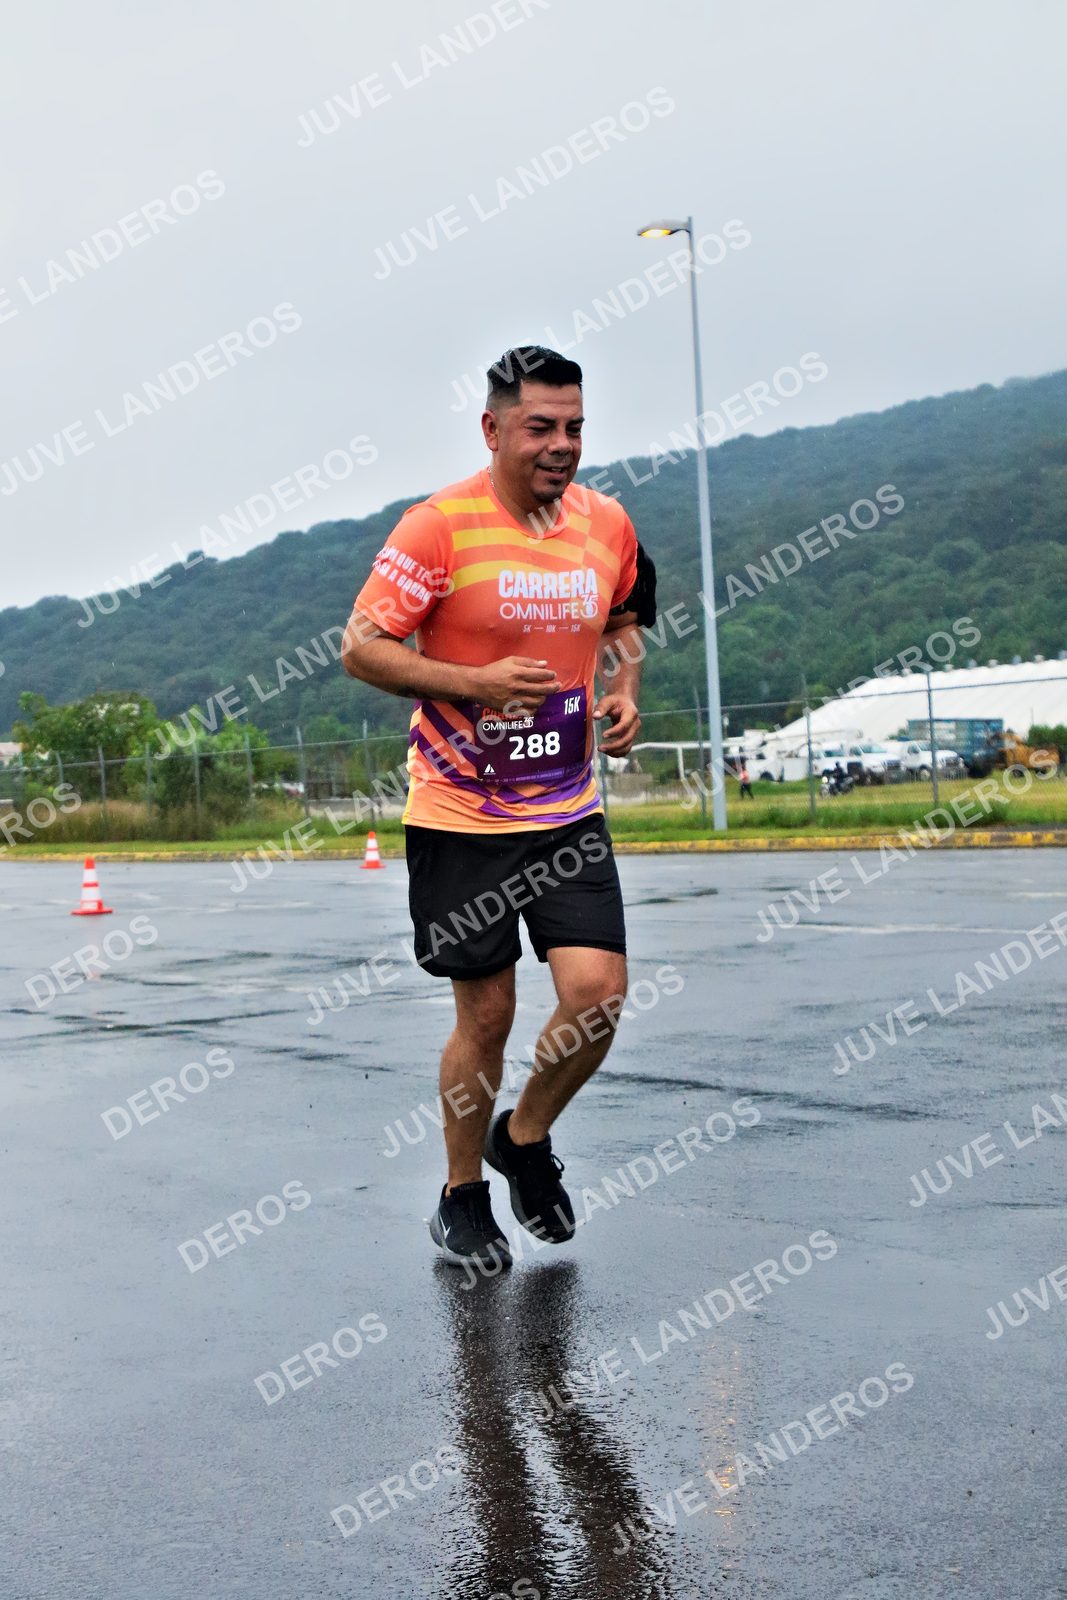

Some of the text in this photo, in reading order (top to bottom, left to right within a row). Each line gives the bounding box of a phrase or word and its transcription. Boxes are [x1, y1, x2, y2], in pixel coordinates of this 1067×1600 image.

[396, 553, 418, 573] QUE
[498, 568, 598, 599] CARRERA
[500, 602, 580, 620] OMNILIFE
[564, 696, 581, 715] 15K
[482, 720, 523, 731] OMNILIFE
[508, 731, 561, 760] 288
